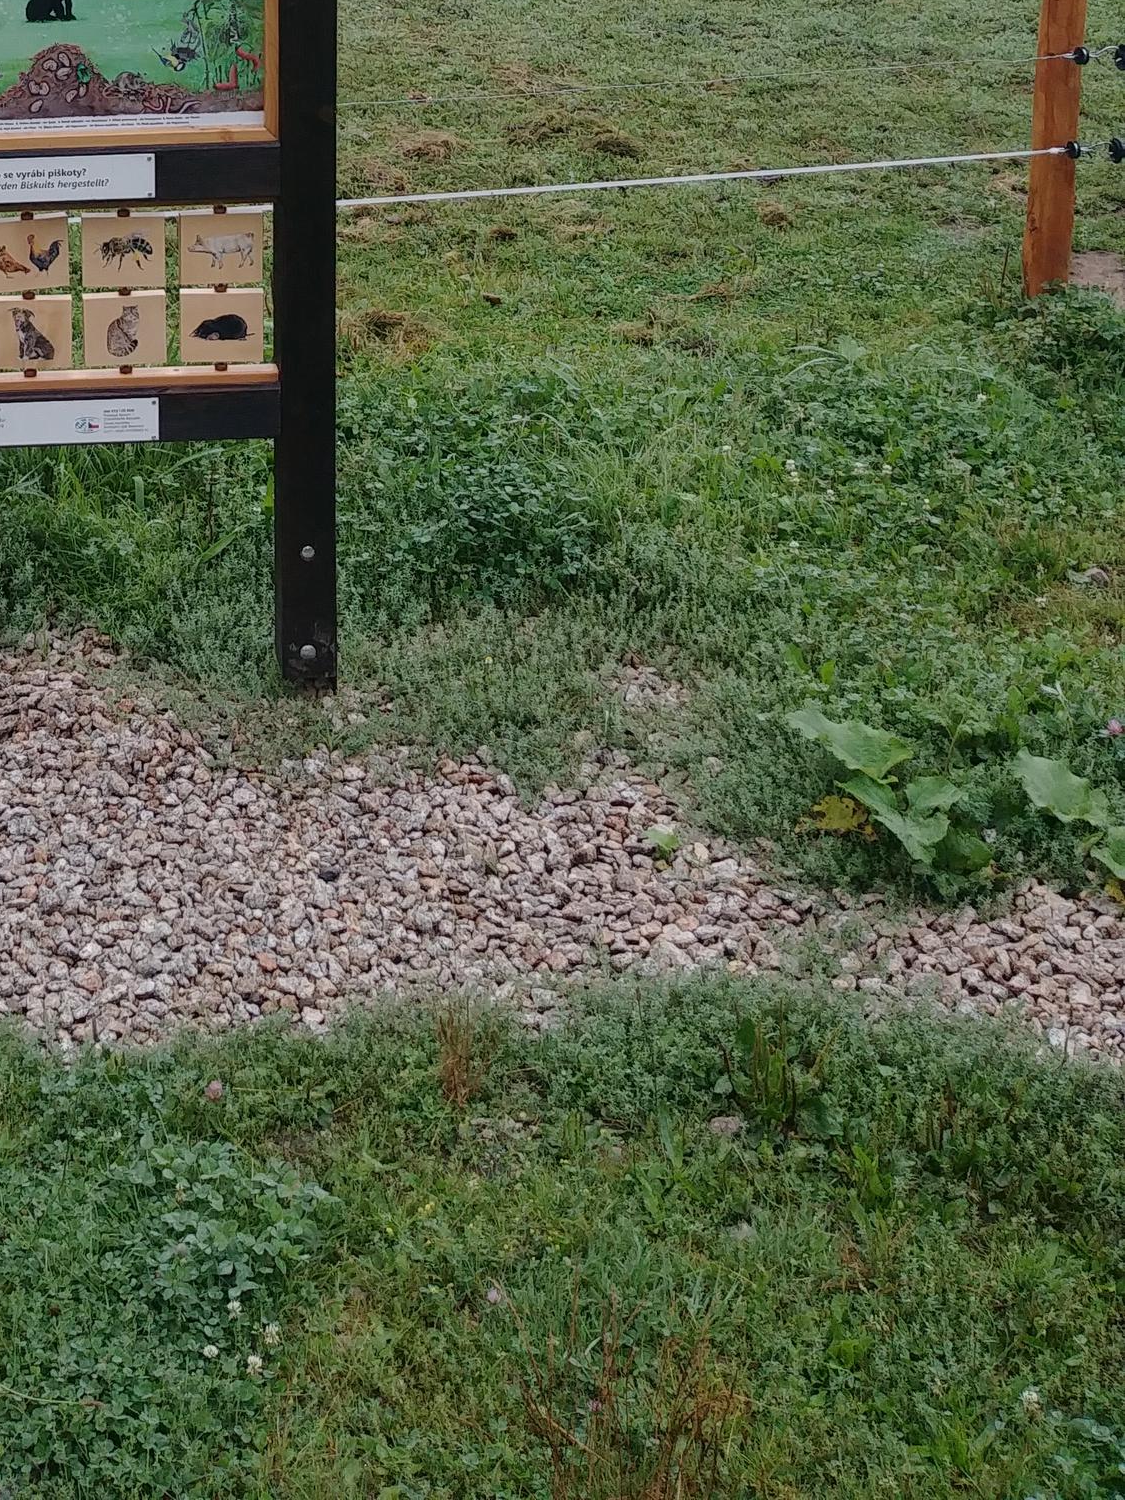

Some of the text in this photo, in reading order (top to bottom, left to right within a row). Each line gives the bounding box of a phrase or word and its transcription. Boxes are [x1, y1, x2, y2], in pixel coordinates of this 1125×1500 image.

[3, 171, 14, 179] se
[47, 168, 87, 179] piškoty?
[20, 180, 55, 190] Biskuits
[57, 178, 109, 190] hergestellt?
